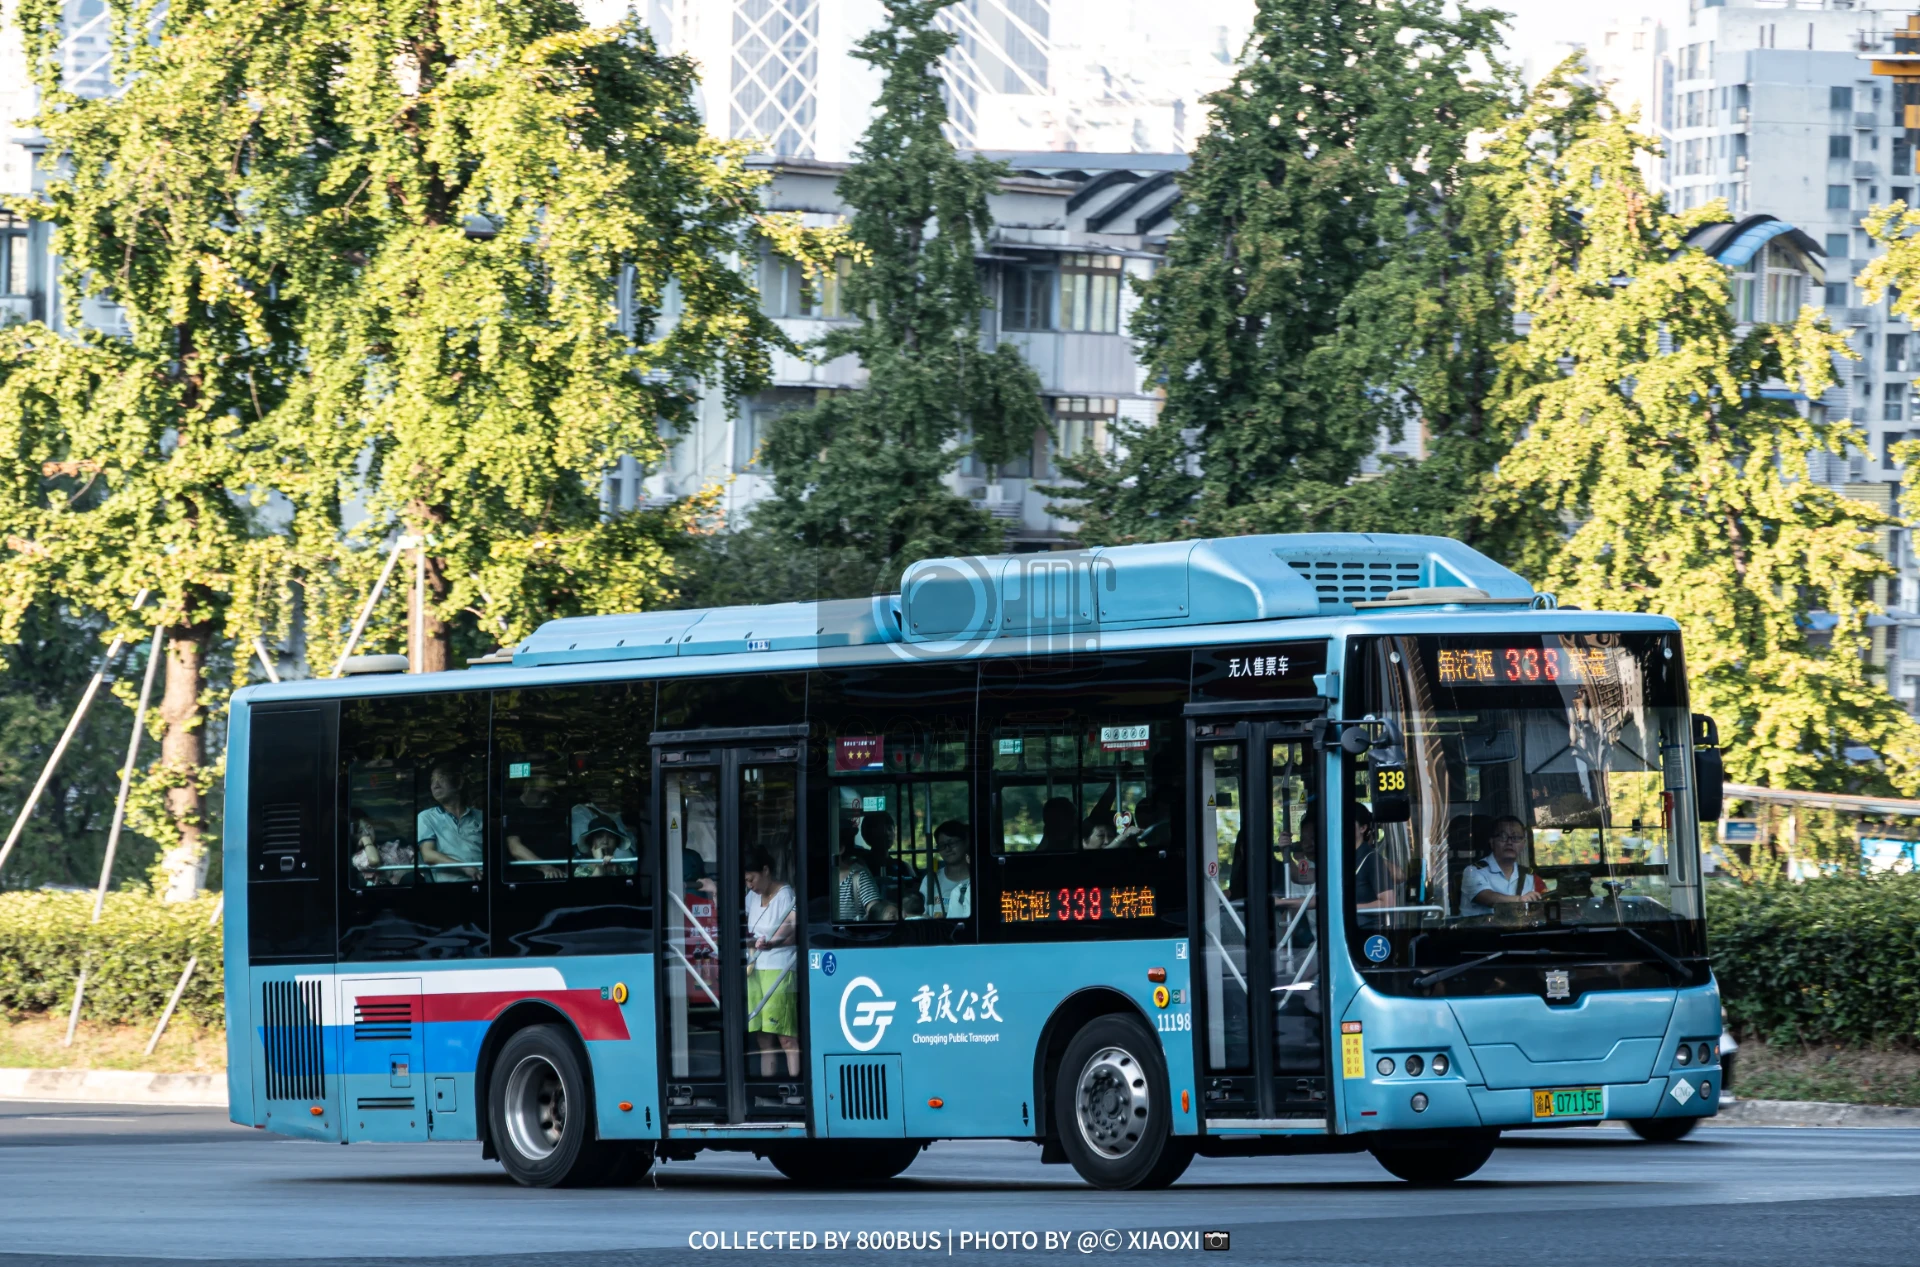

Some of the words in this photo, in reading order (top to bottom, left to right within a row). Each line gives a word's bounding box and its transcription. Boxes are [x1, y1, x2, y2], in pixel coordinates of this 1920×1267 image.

[1228, 655, 1289, 678] 无人售票车
[1505, 648, 1559, 681] 338
[1378, 770, 1405, 791] 338
[1058, 887, 1101, 921] 338
[911, 982, 1003, 1024] 重庆公交
[1157, 1012, 1191, 1032] 11198
[912, 1033, 947, 1046] Chongqing
[948, 1032, 968, 1043] Public
[968, 1032, 999, 1044] Transport
[1674, 1087, 1691, 1097] CNG
